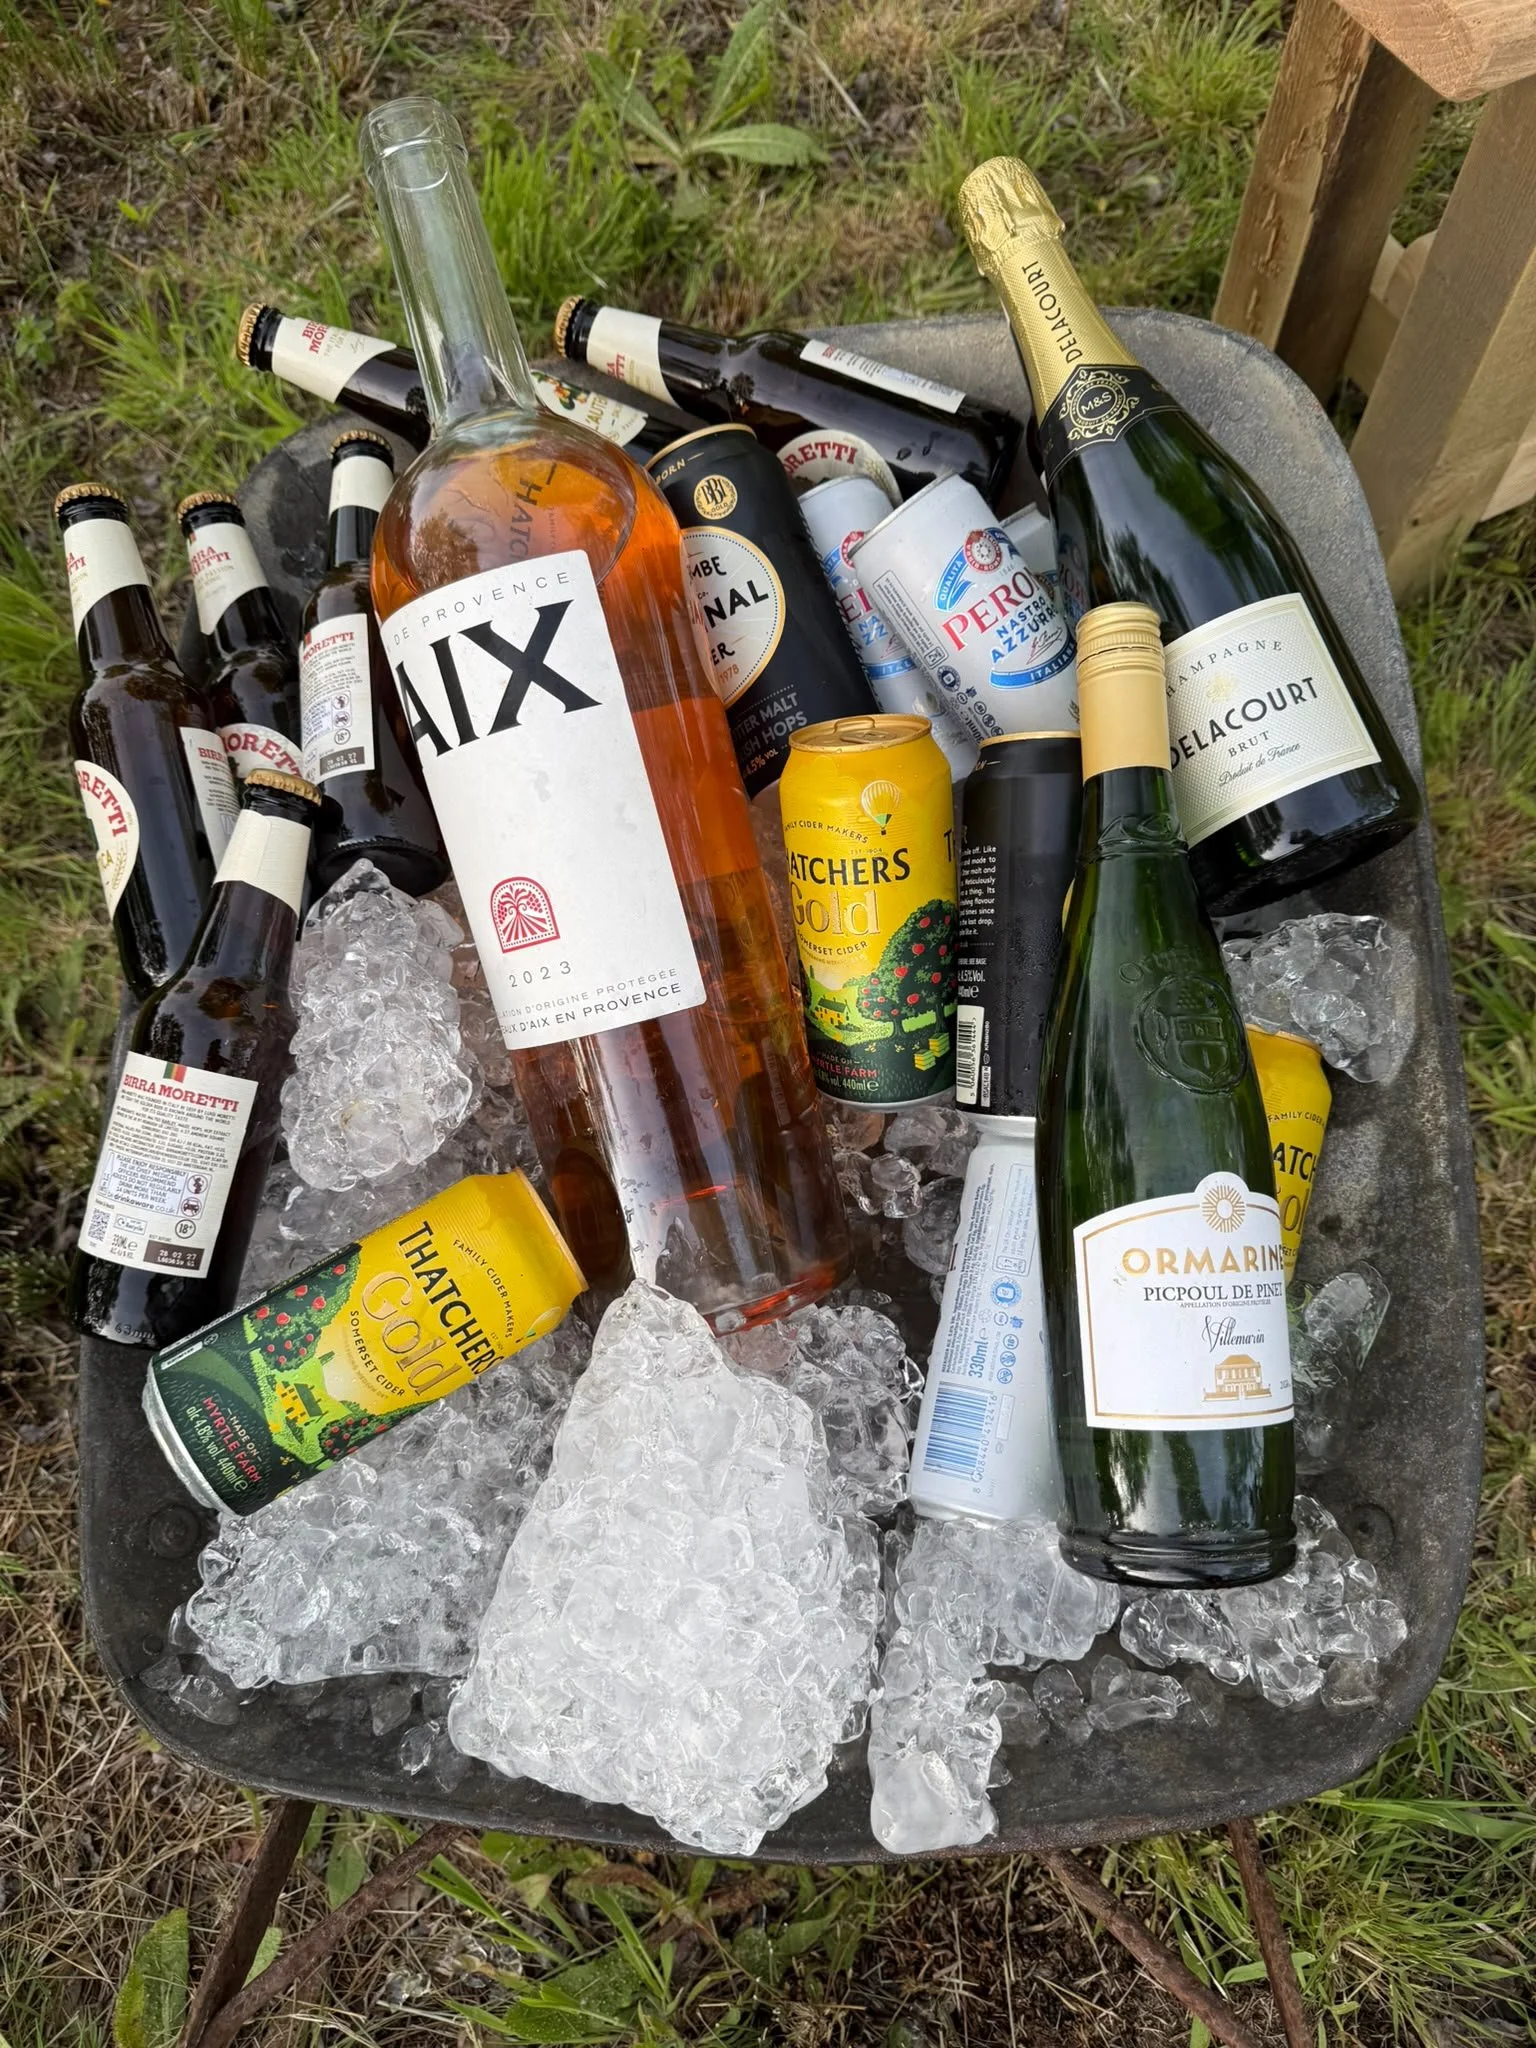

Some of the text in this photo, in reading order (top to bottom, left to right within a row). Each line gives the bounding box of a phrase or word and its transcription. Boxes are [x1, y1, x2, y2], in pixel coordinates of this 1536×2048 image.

[1022, 261, 1083, 364] DELACOURT
[1081, 391, 1112, 414] M&S
[711, 502, 729, 513] GOLD
[692, 555, 727, 579] MBE
[394, 571, 570, 646] DE PROVENCE
[703, 580, 769, 629] NAL
[996, 596, 1046, 639] NASTRO
[711, 642, 735, 666] ER
[882, 658, 913, 675] ITAL
[394, 599, 603, 758] AIX
[1166, 639, 1282, 698] HAMPAGNE
[759, 692, 798, 722] MALT
[761, 711, 808, 744] HOPS
[964, 718, 984, 744] 30ml
[224, 733, 303, 778] ORET
[764, 748, 779, 760] VOL
[1228, 730, 1269, 758] BRUT
[1218, 742, 1301, 787] Produit de France
[77, 769, 128, 837] RETTI
[798, 819, 869, 845] CIDER MAKERS
[971, 856, 986, 864] made
[982, 844, 996, 852] Like
[786, 847, 911, 887] ATCHERS
[982, 865, 996, 873] and
[968, 888, 983, 896] thing.
[974, 896, 994, 904] flavour
[790, 882, 881, 936] Gold
[977, 918, 993, 926] drop,
[836, 939, 867, 956] CIDER
[507, 960, 573, 989] 2023
[524, 967, 678, 1014] D'ORIGINE PROTÉGÉE
[519, 982, 682, 1031] D'AIX EN PROVENCE
[844, 1067, 876, 1077] FARM
[123, 1074, 240, 1112] BIRRA MORETTI
[1267, 1109, 1302, 1124] FAMILY
[116, 1154, 186, 1176] PLEASE ENJOY RESPONSIBLY
[117, 1167, 176, 1186] OFFICERS RECOMMEND
[135, 1166, 151, 1174] CHIEF
[151, 1170, 177, 1180] MEDICAL
[112, 1172, 128, 1181] ADULTS
[148, 1181, 181, 1194] REGULARLY
[118, 1180, 166, 1197] DRINK MORE THAN
[122, 1188, 137, 1196] UNITS
[178, 1222, 193, 1234] 18+
[186, 1252, 197, 1260] 27
[398, 1220, 505, 1376] THATCHERS
[452, 1239, 515, 1338] FAMILY CIDER MAKERS
[1144, 1282, 1283, 1301] PICPOUL DE PINET
[361, 1270, 462, 1396] Gold
[349, 1309, 406, 1398] SOMERSET CIDER
[968, 1340, 988, 1378] 330ml
[184, 1402, 204, 1422] alc
[983, 1394, 997, 1434] 412416
[191, 1416, 217, 1444] 4.8%
[198, 1395, 262, 1484] MYRTLE FARM
[228, 1415, 259, 1456] MADE ON
[204, 1438, 226, 1460] vol.
